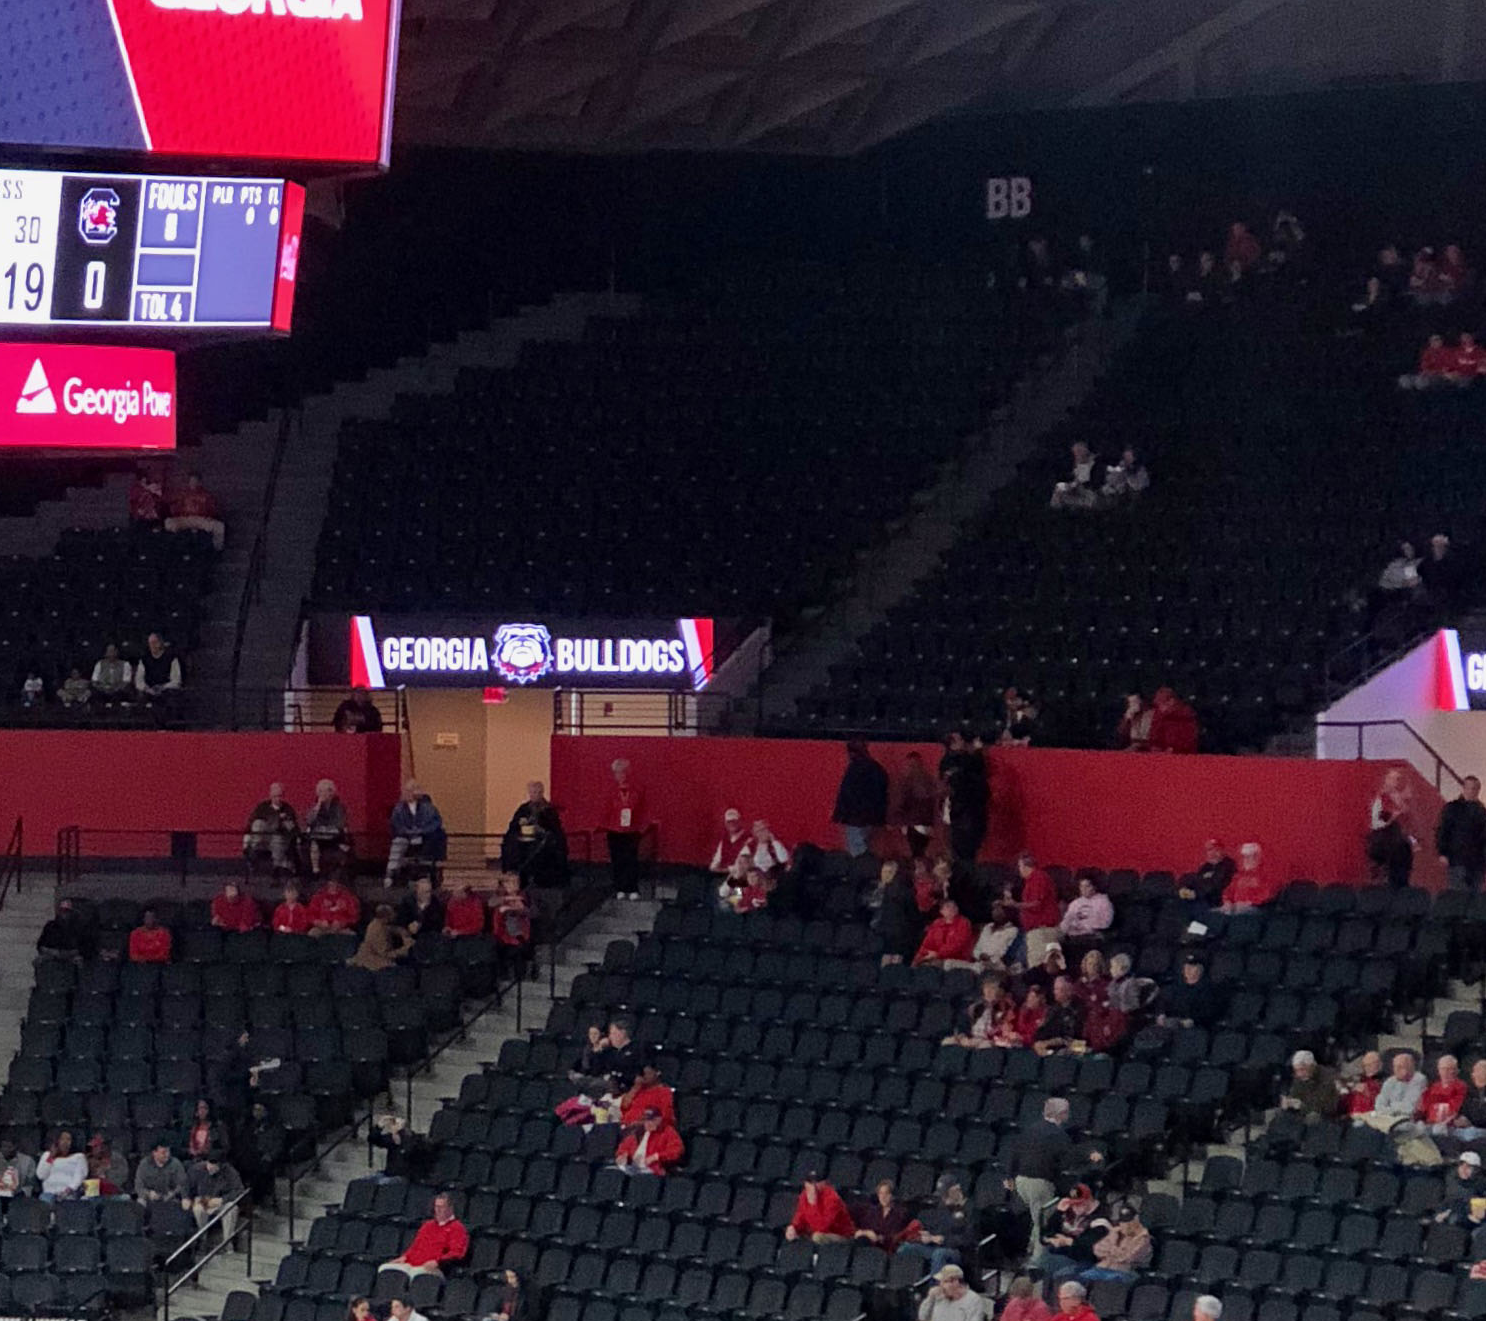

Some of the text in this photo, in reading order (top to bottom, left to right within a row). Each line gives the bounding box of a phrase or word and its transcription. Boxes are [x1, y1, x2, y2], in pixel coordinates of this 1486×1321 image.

[149, 183, 198, 210] FOULS
[212, 186, 279, 205] PLR PTS FL
[987, 177, 1031, 219] BB
[15, 216, 41, 243] 30
[164, 213, 178, 241] 0
[245, 207, 279, 225] 0 0
[84, 261, 106, 309] 0
[141, 294, 182, 320] TOL 4
[63, 377, 139, 424] Georgia
[382, 637, 685, 672] GEORGIA BULLDOGS
